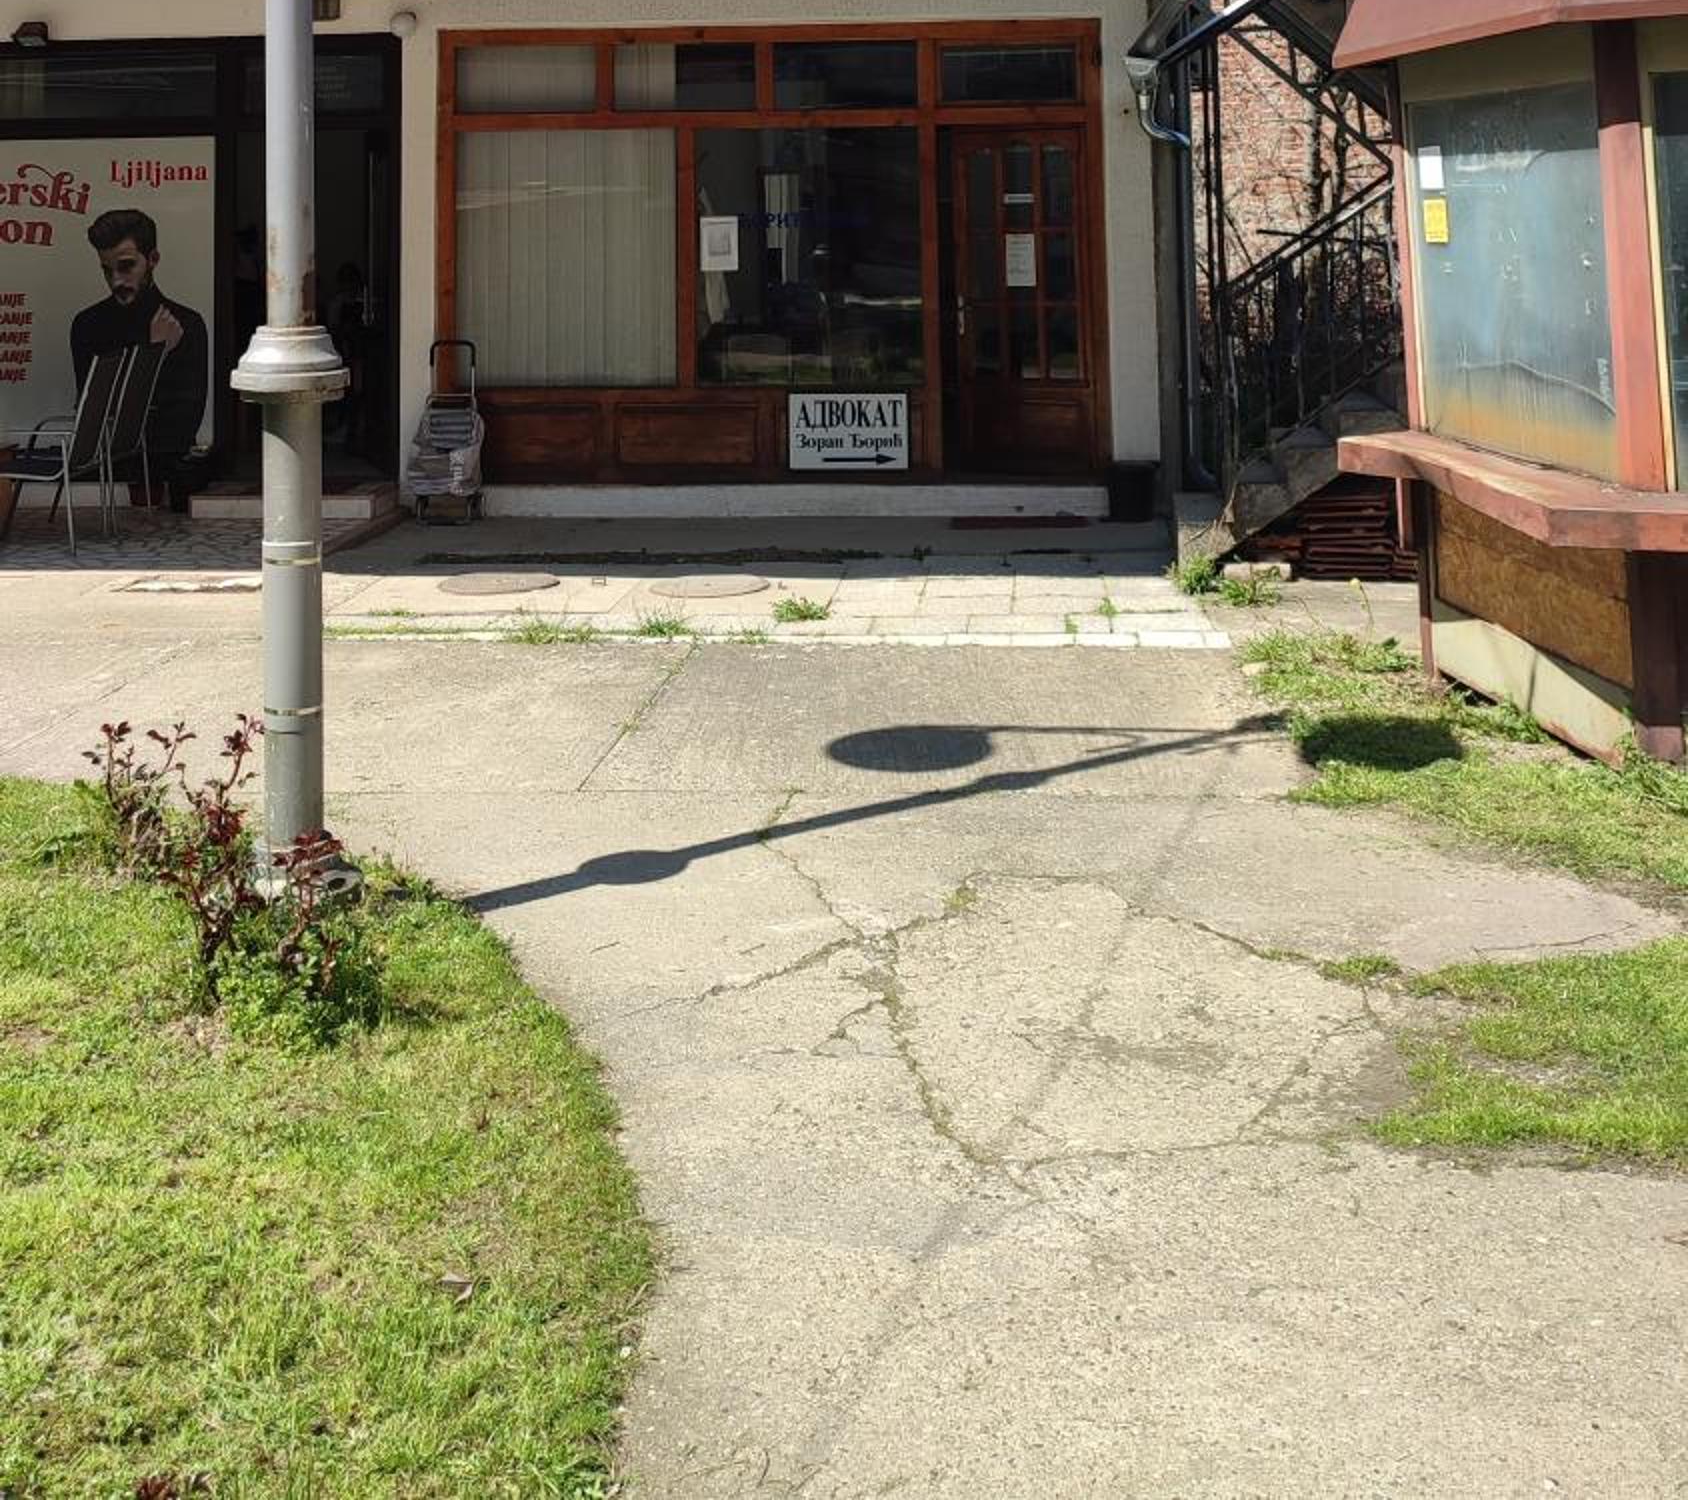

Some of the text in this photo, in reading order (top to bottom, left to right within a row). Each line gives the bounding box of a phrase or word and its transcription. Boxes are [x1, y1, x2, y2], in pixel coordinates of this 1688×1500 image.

[110, 160, 209, 188] Ljiljana
[0, 311, 33, 326] ANJE
[795, 399, 903, 433] АДВОКАТ
[795, 433, 903, 452] Зоран Ђорић
